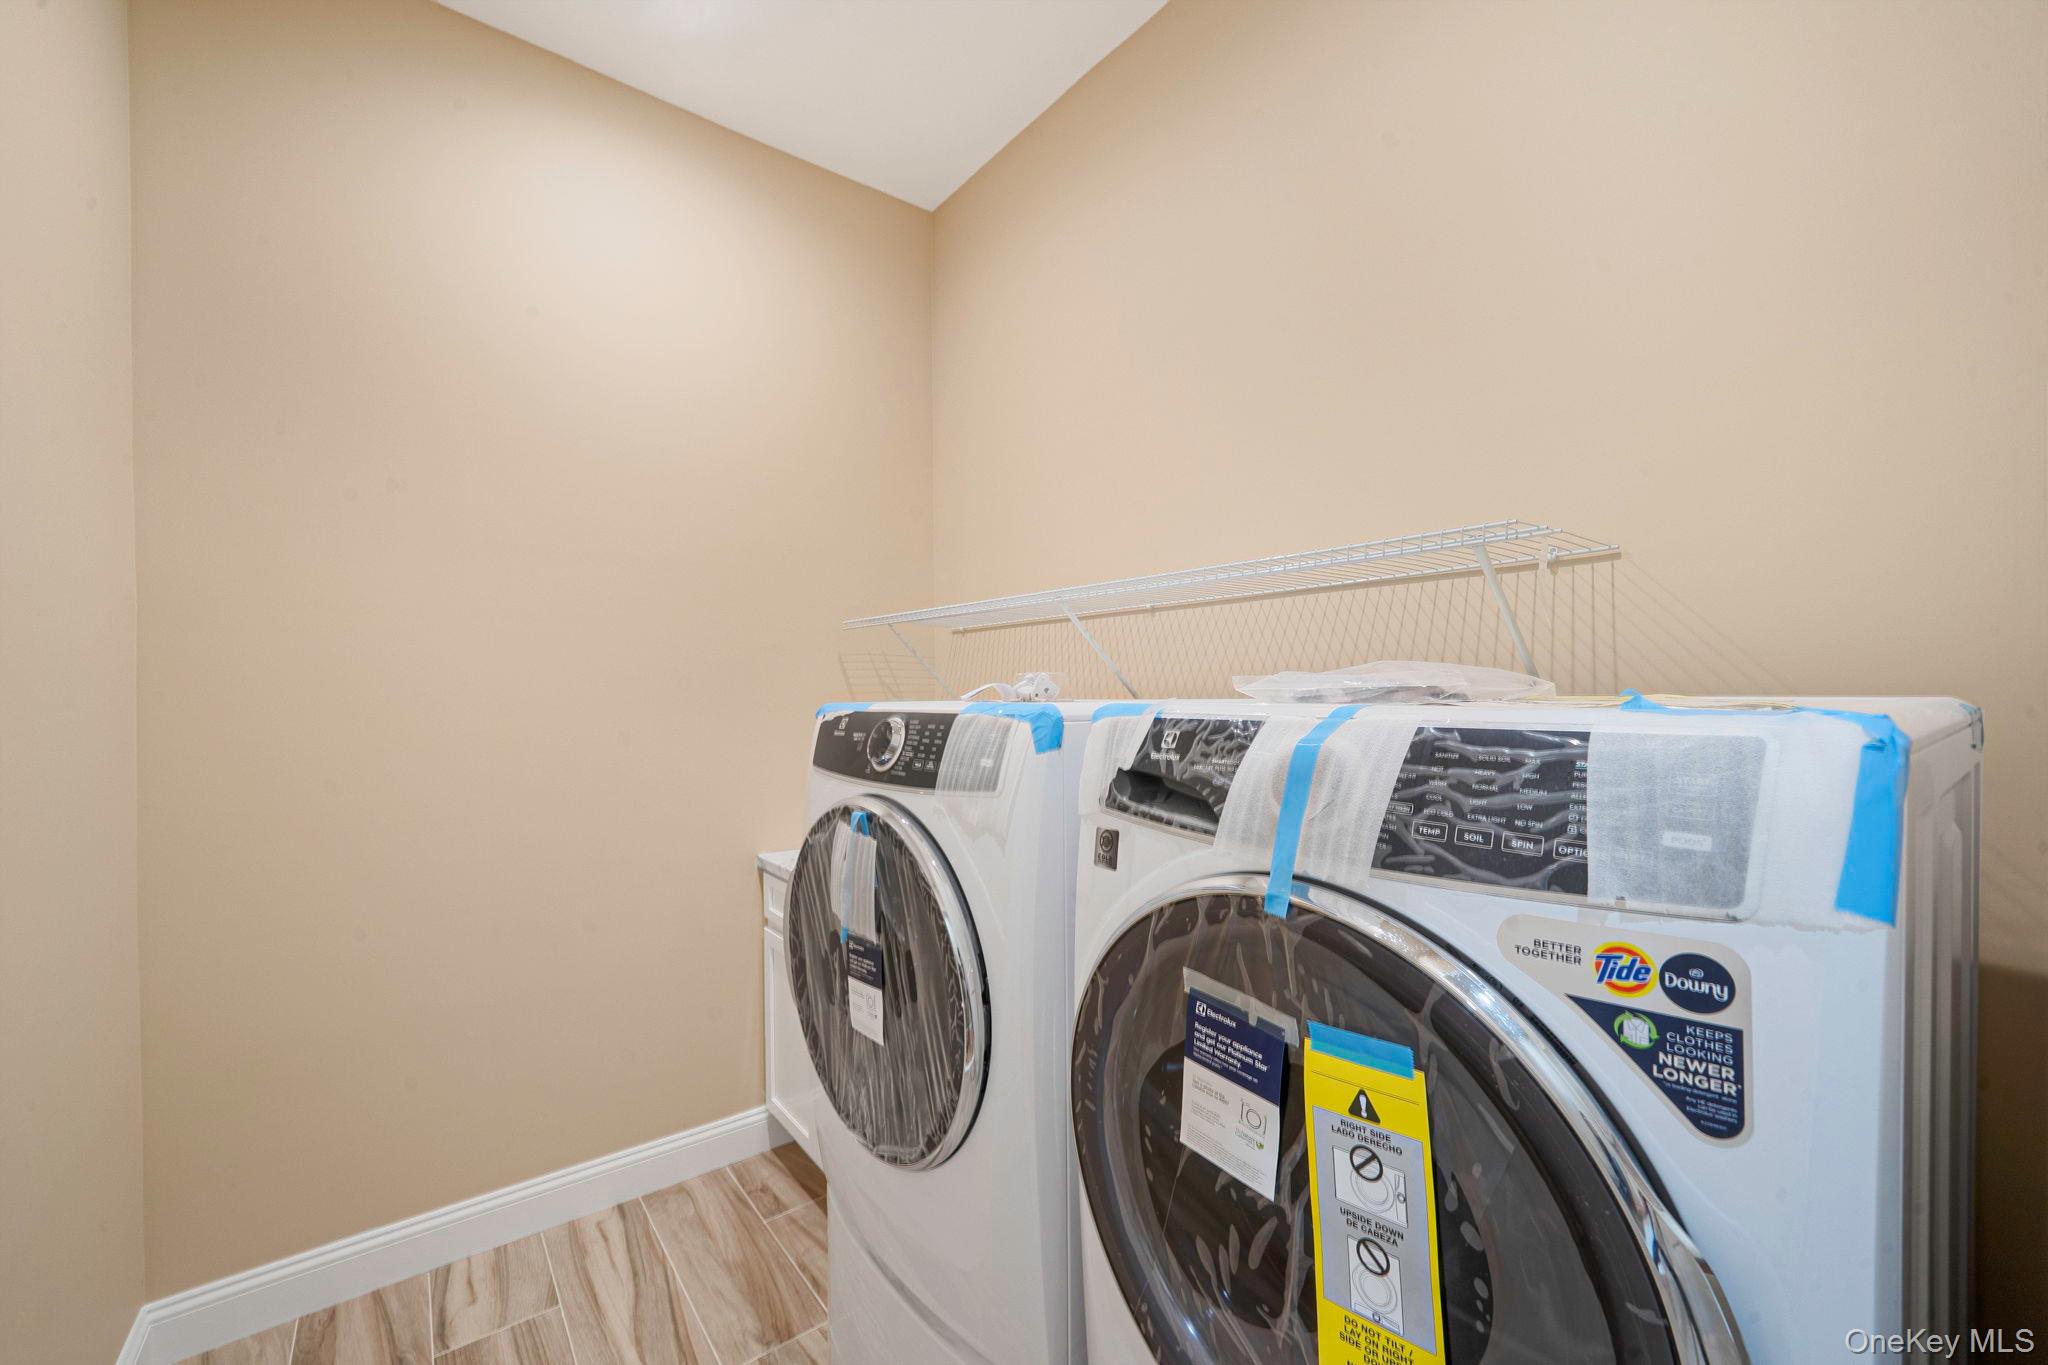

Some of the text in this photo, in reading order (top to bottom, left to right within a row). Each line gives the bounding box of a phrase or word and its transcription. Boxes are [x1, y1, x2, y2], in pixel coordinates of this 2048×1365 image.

[1419, 825, 1441, 836] TEMP
[1463, 832, 1485, 843] SOIL
[1511, 840, 1534, 850] SPIN
[1558, 845, 1592, 858] OPTIO
[1514, 945, 1582, 966] TOGETHER
[1533, 938, 1582, 955] BETTER
[1595, 953, 1652, 984] Tide
[1664, 971, 1729, 1002] Downy
[1206, 1007, 1237, 1029] Electrolux
[1194, 1021, 1217, 1038] Register
[1218, 1033, 1231, 1044] your
[1232, 1040, 1263, 1061] appliance
[1666, 1031, 1733, 1054] CLOTHES
[1686, 1024, 1733, 1043] KEEPS
[1193, 1037, 1214, 1054] Limited
[1194, 1030, 1205, 1041] and
[1206, 1036, 1216, 1047] get
[1216, 1042, 1226, 1052] our
[1227, 1046, 1254, 1066] Platinum
[1666, 1042, 1733, 1065] LOOKING
[1658, 1051, 1735, 1081] NEWER
[1331, 1124, 1403, 1156] LADO DERECHO
[1340, 1119, 1391, 1142] RIGHT SIDE
[1340, 1206, 1404, 1240] UPSIDE DOWN
[1346, 1218, 1398, 1248] DE CABEZA
[1339, 1331, 1361, 1350] SIDE
[1364, 1345, 1379, 1359] OR
[1344, 1314, 1358, 1328] DO
[1361, 1323, 1381, 1340] NOT
[1385, 1336, 1405, 1353] TILT
[1344, 1325, 1414, 1365] LAY ON RIGHT
